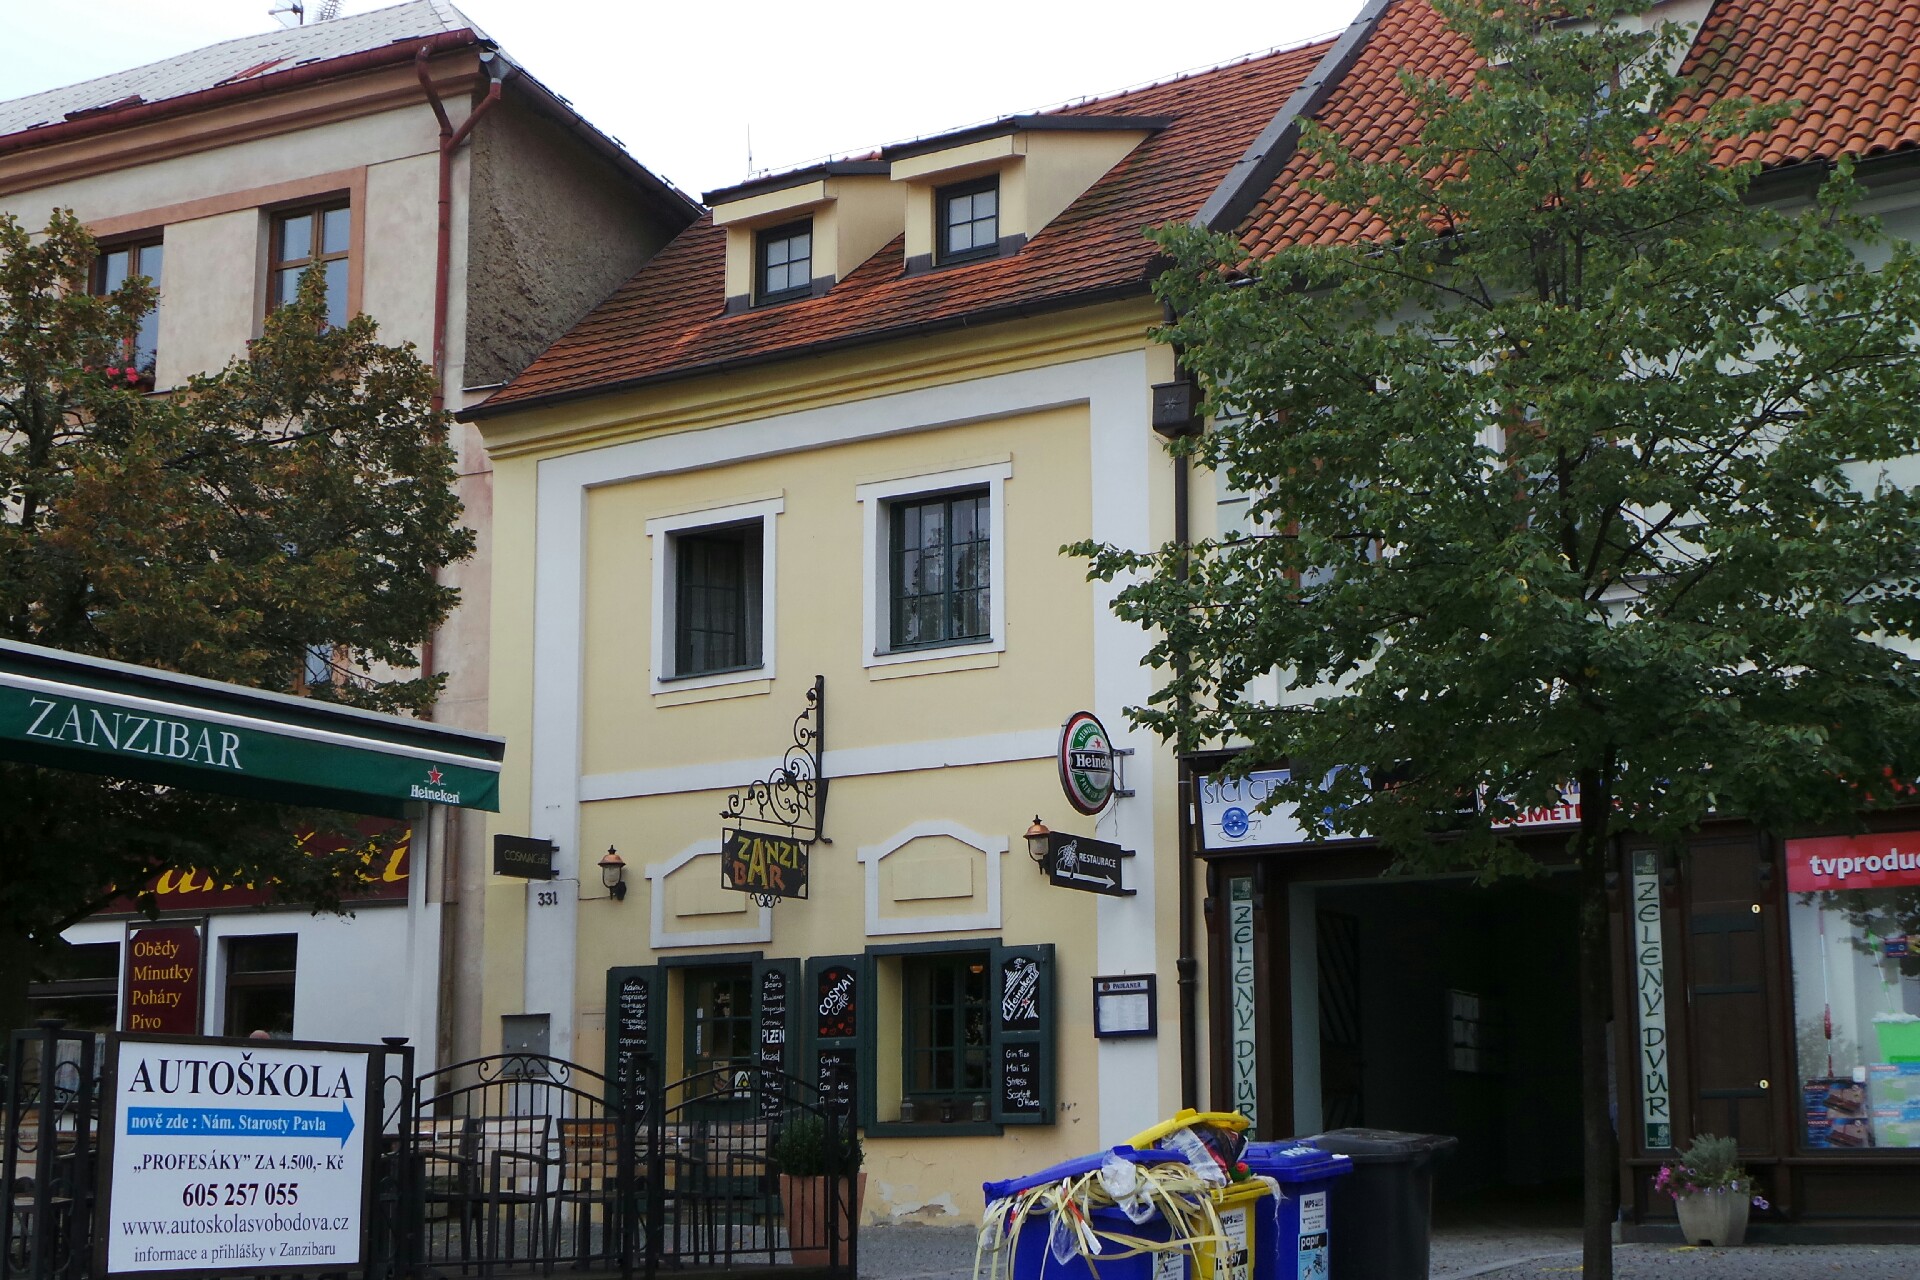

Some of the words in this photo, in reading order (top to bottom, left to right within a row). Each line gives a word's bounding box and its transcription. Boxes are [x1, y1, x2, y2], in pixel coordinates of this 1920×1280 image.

[26, 697, 243, 770] ZANZIBAR
[410, 785, 461, 804] Heineken
[738, 836, 798, 873] ZANZI
[1078, 852, 1116, 868] RESTAURACE
[538, 891, 558, 906] 331
[134, 940, 180, 959] Obědy
[1638, 881, 1663, 1017] ZELENÝ
[133, 963, 194, 983] Minutky
[1234, 906, 1254, 1032] ZELENÝ
[819, 974, 855, 1016] COSMAI
[1005, 971, 1036, 1011] Heineken
[1112, 981, 1141, 990] PAULANER
[132, 988, 182, 1008] Poháry
[131, 1014, 162, 1030] Pivo
[128, 1051, 354, 1099] AUTOŠKOLA
[1235, 1039, 1256, 1122] DVŮR
[1642, 1027, 1668, 1118] DVŮR
[131, 1113, 163, 1129] nově
[166, 1113, 189, 1129] zde
[201, 1114, 235, 1130] Nám.
[238, 1115, 290, 1134] Starosty
[293, 1116, 326, 1131] Pavla
[255, 1154, 276, 1170] ZA
[279, 1154, 322, 1173] 4.500,-
[326, 1154, 344, 1170] Kč
[182, 1182, 218, 1206] 605
[224, 1182, 259, 1206] 257
[264, 1182, 298, 1206] 055
[122, 1212, 349, 1236] www.autoskolasvobodova.cz
[134, 1246, 197, 1262] informace
[201, 1250, 207, 1260] a
[211, 1243, 265, 1263] přihlášky
[269, 1247, 276, 1258] v
[280, 1241, 336, 1258] Zanzibaru
